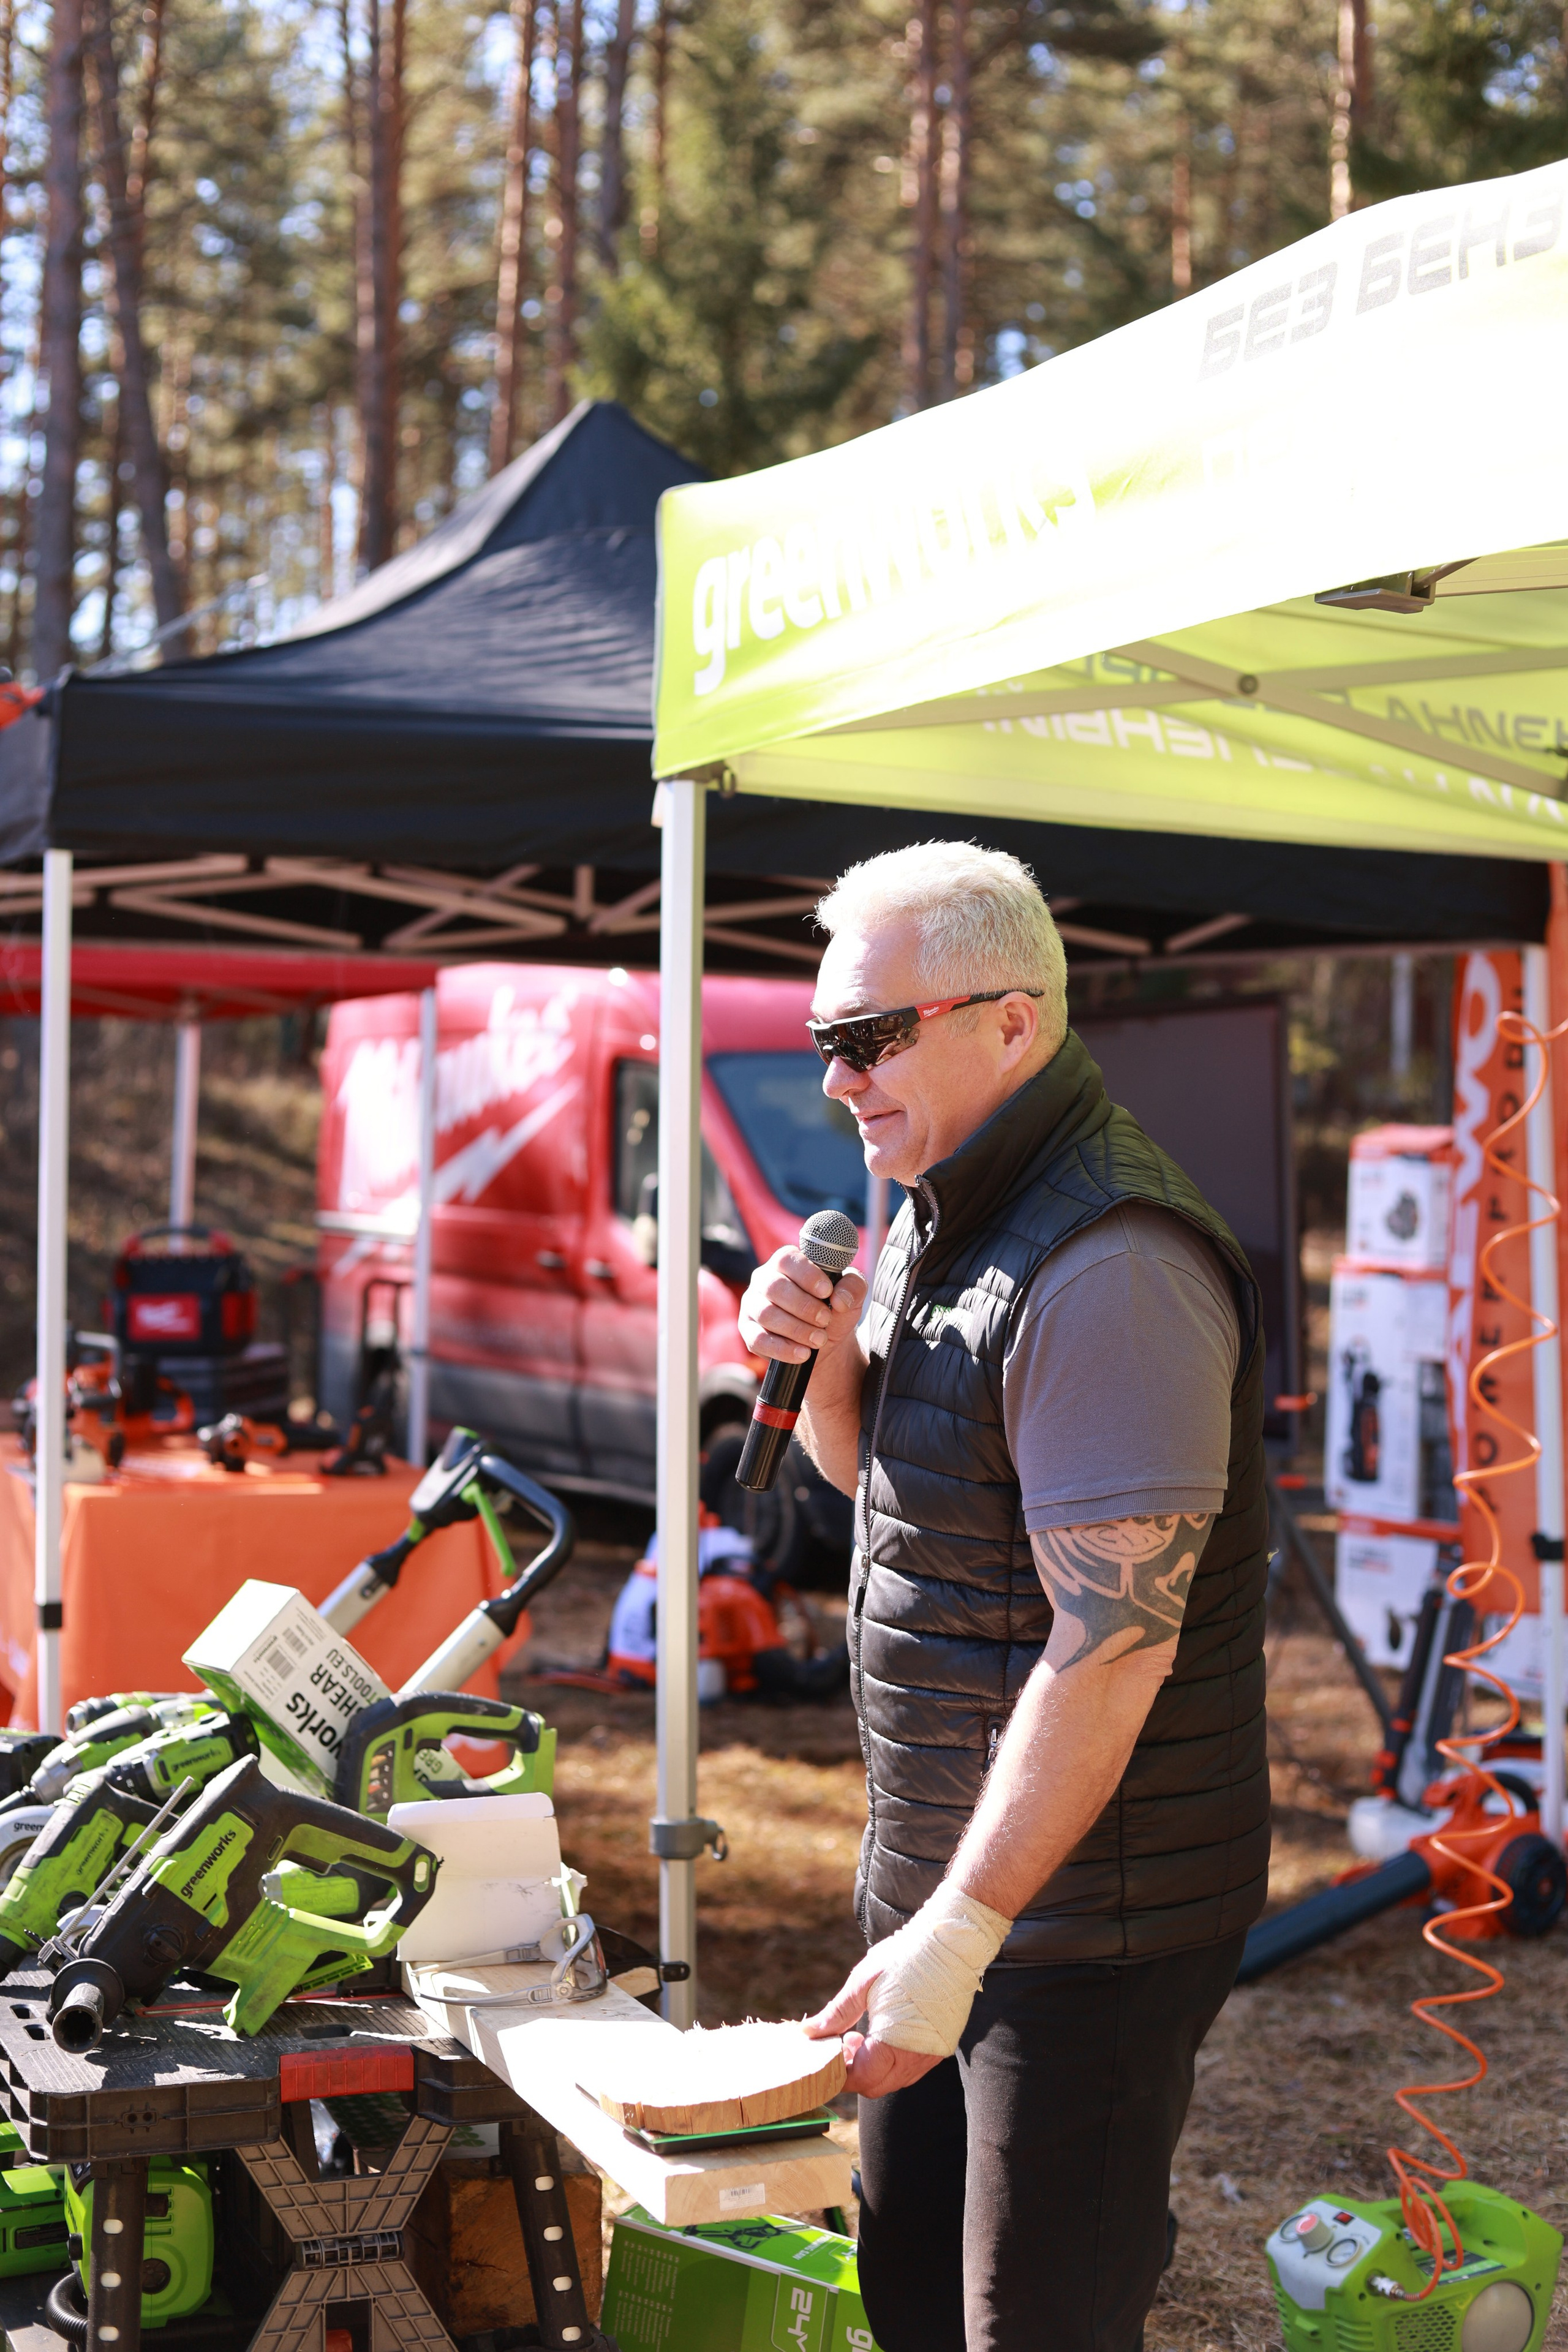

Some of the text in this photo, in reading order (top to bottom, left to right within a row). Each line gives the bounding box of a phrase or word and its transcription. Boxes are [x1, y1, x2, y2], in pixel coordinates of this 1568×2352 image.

[1196, 261, 1338, 384] БЕЗ
[693, 458, 1095, 696] greenworks
[309, 1664, 365, 1717] HEAR
[76, 1828, 109, 1875] greenworks
[180, 1829, 237, 1899] greenworks
